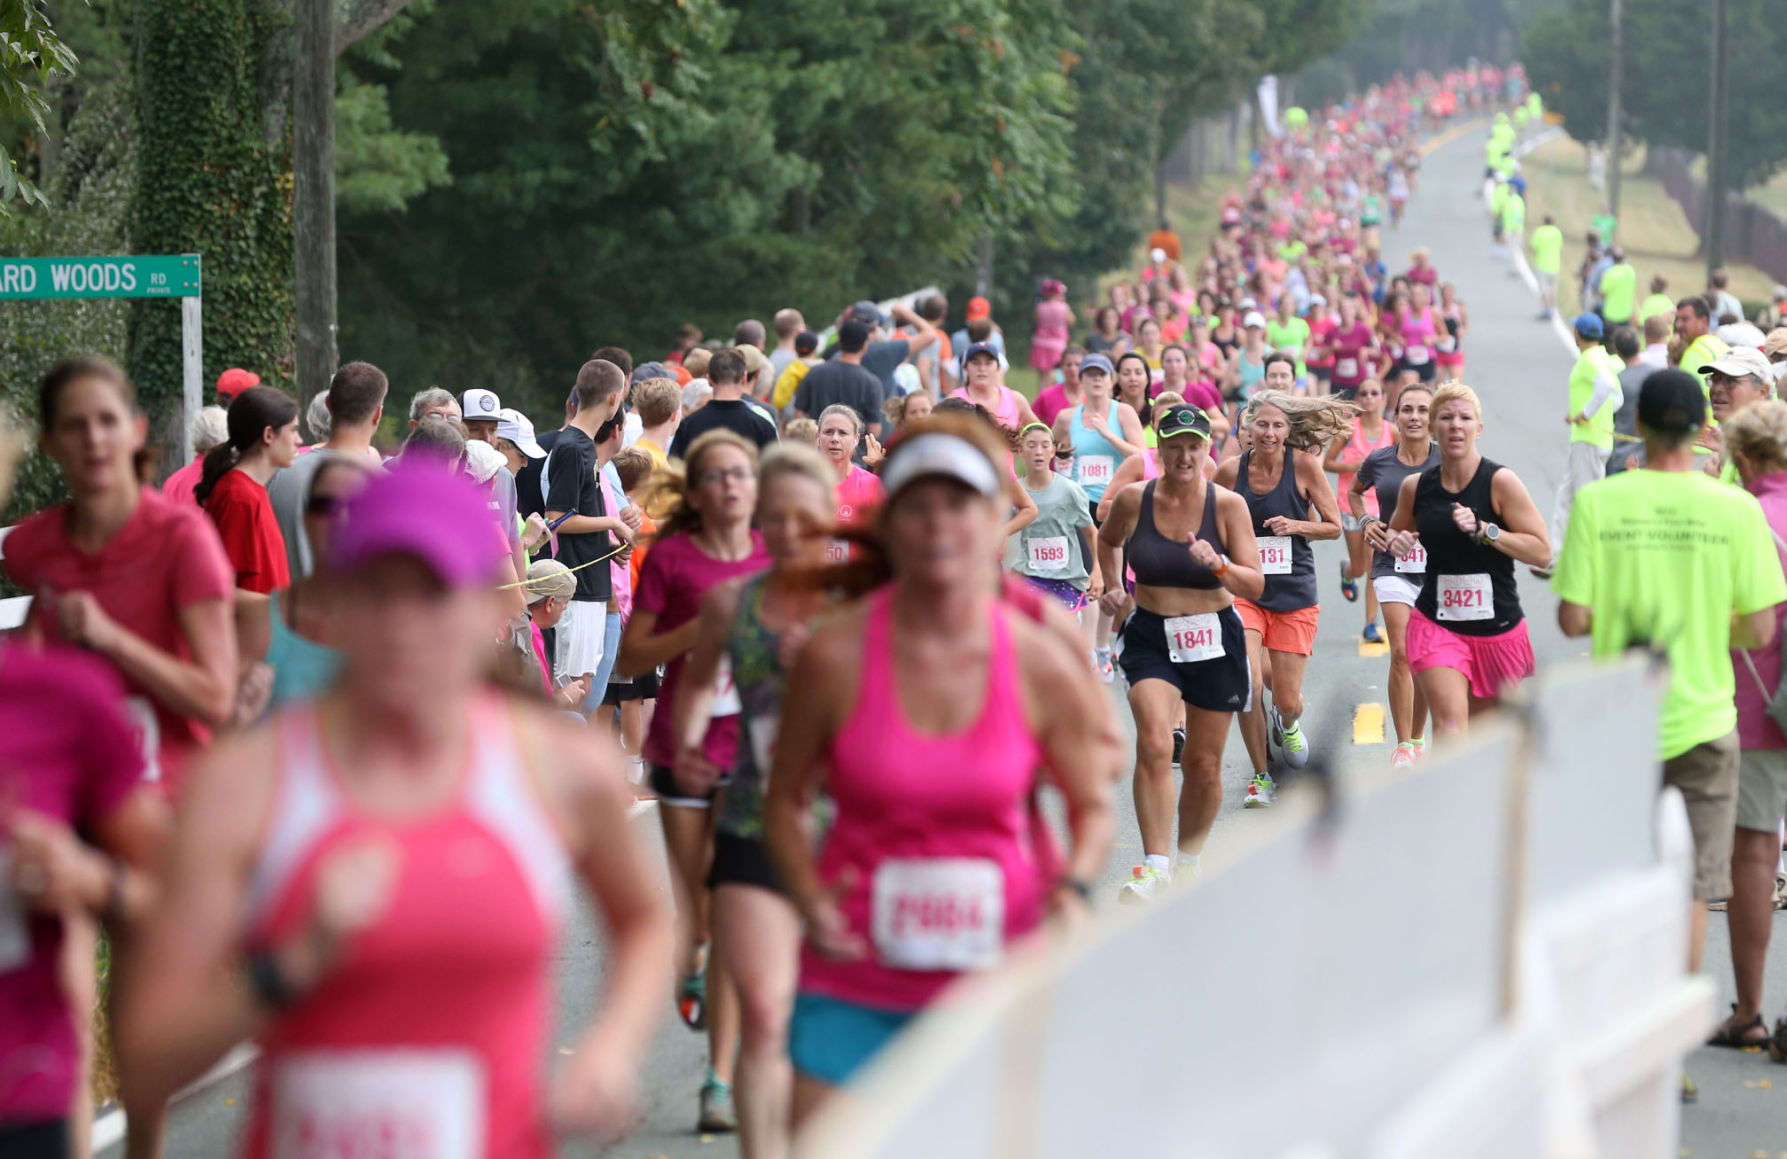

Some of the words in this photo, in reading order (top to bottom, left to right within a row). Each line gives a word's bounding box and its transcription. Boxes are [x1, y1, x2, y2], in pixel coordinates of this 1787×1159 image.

[0, 265, 36, 293] RD
[51, 263, 137, 291] WOODS
[151, 273, 166, 285] RD
[1082, 465, 1107, 476] 1081
[1034, 547, 1064, 561] 1593
[1443, 589, 1483, 608] 3421
[1173, 628, 1213, 650] 1841
